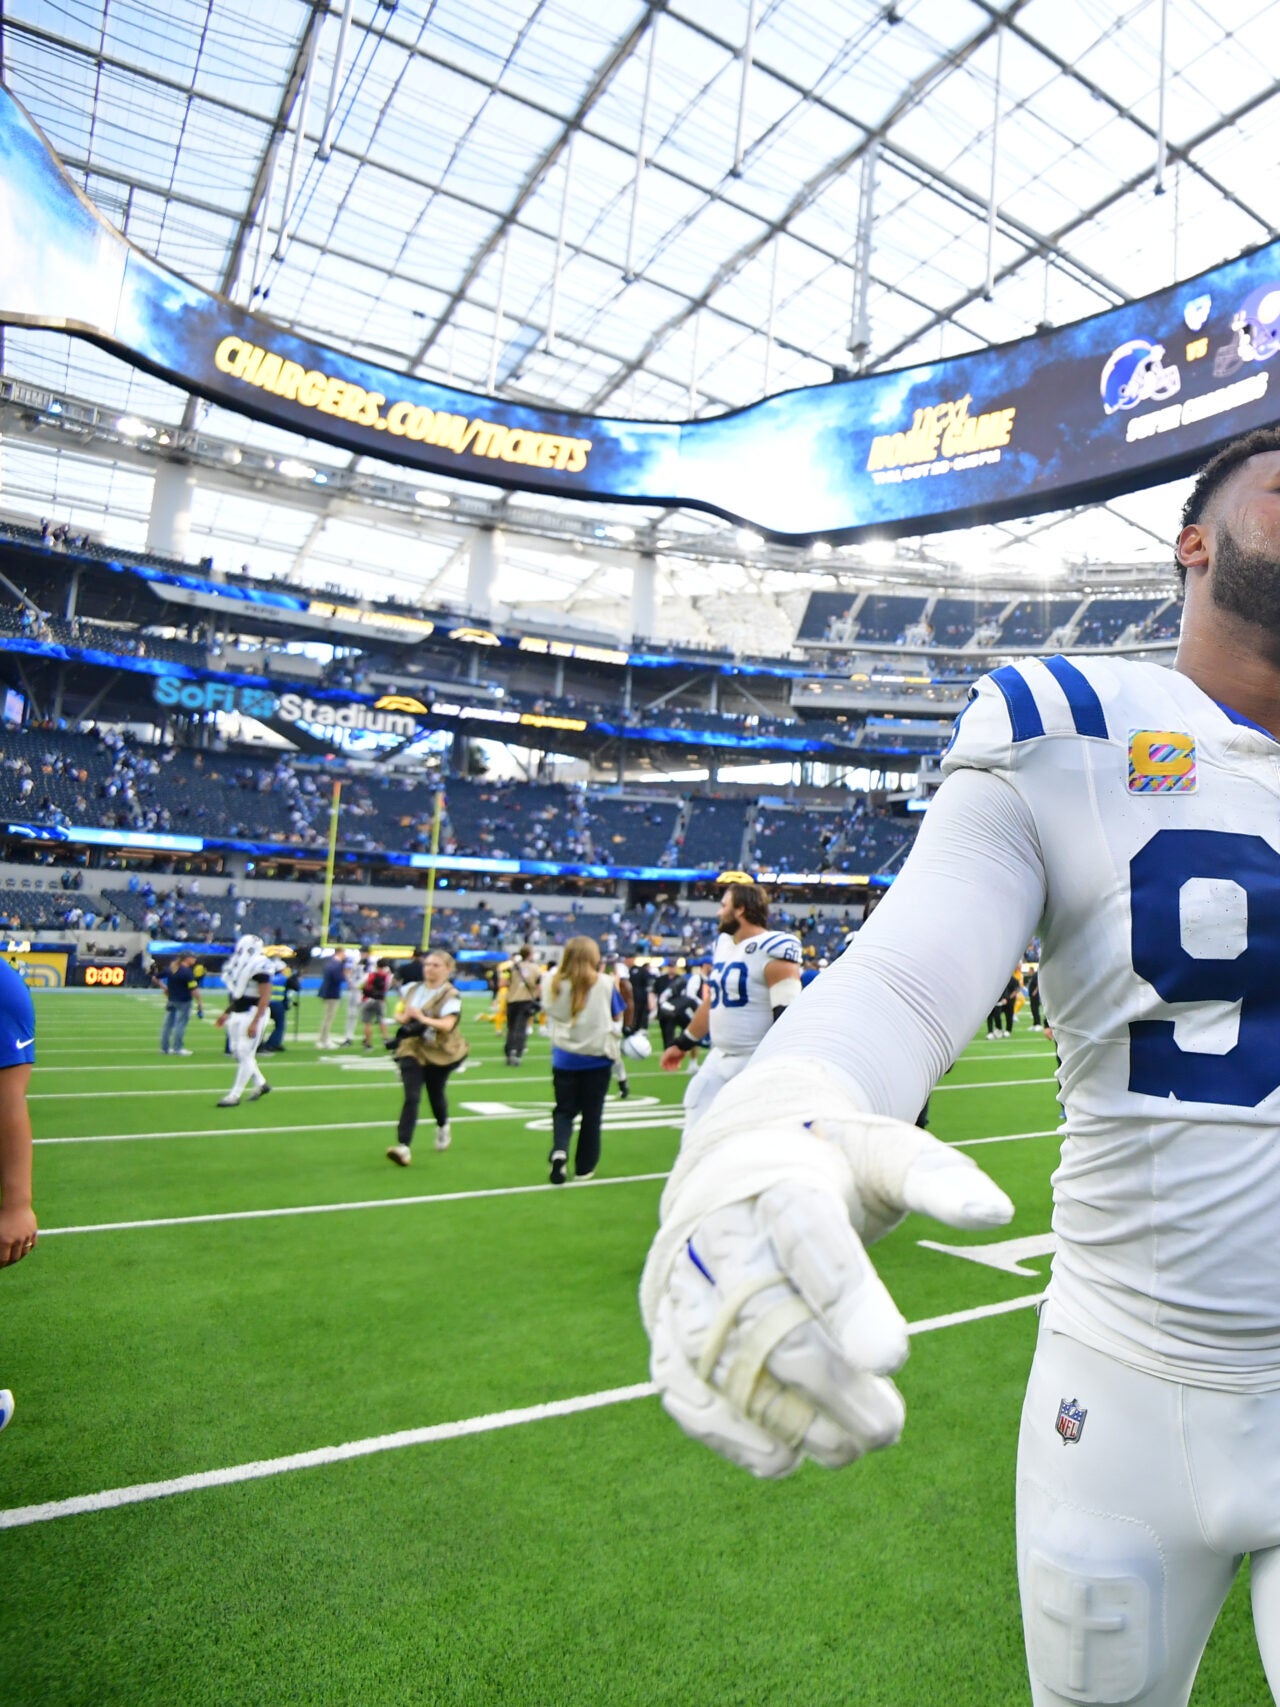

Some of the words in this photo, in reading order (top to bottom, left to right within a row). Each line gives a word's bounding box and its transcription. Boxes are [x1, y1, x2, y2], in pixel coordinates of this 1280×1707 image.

[214, 336, 593, 472] CHARGERS.COM/TICKETS
[941, 407, 1016, 457] GAME
[155, 677, 236, 711] SoFi
[279, 693, 415, 735] Stadium
[1132, 731, 1193, 776] C
[85, 966, 125, 985] 0:00
[1059, 1415, 1077, 1437] NFL
